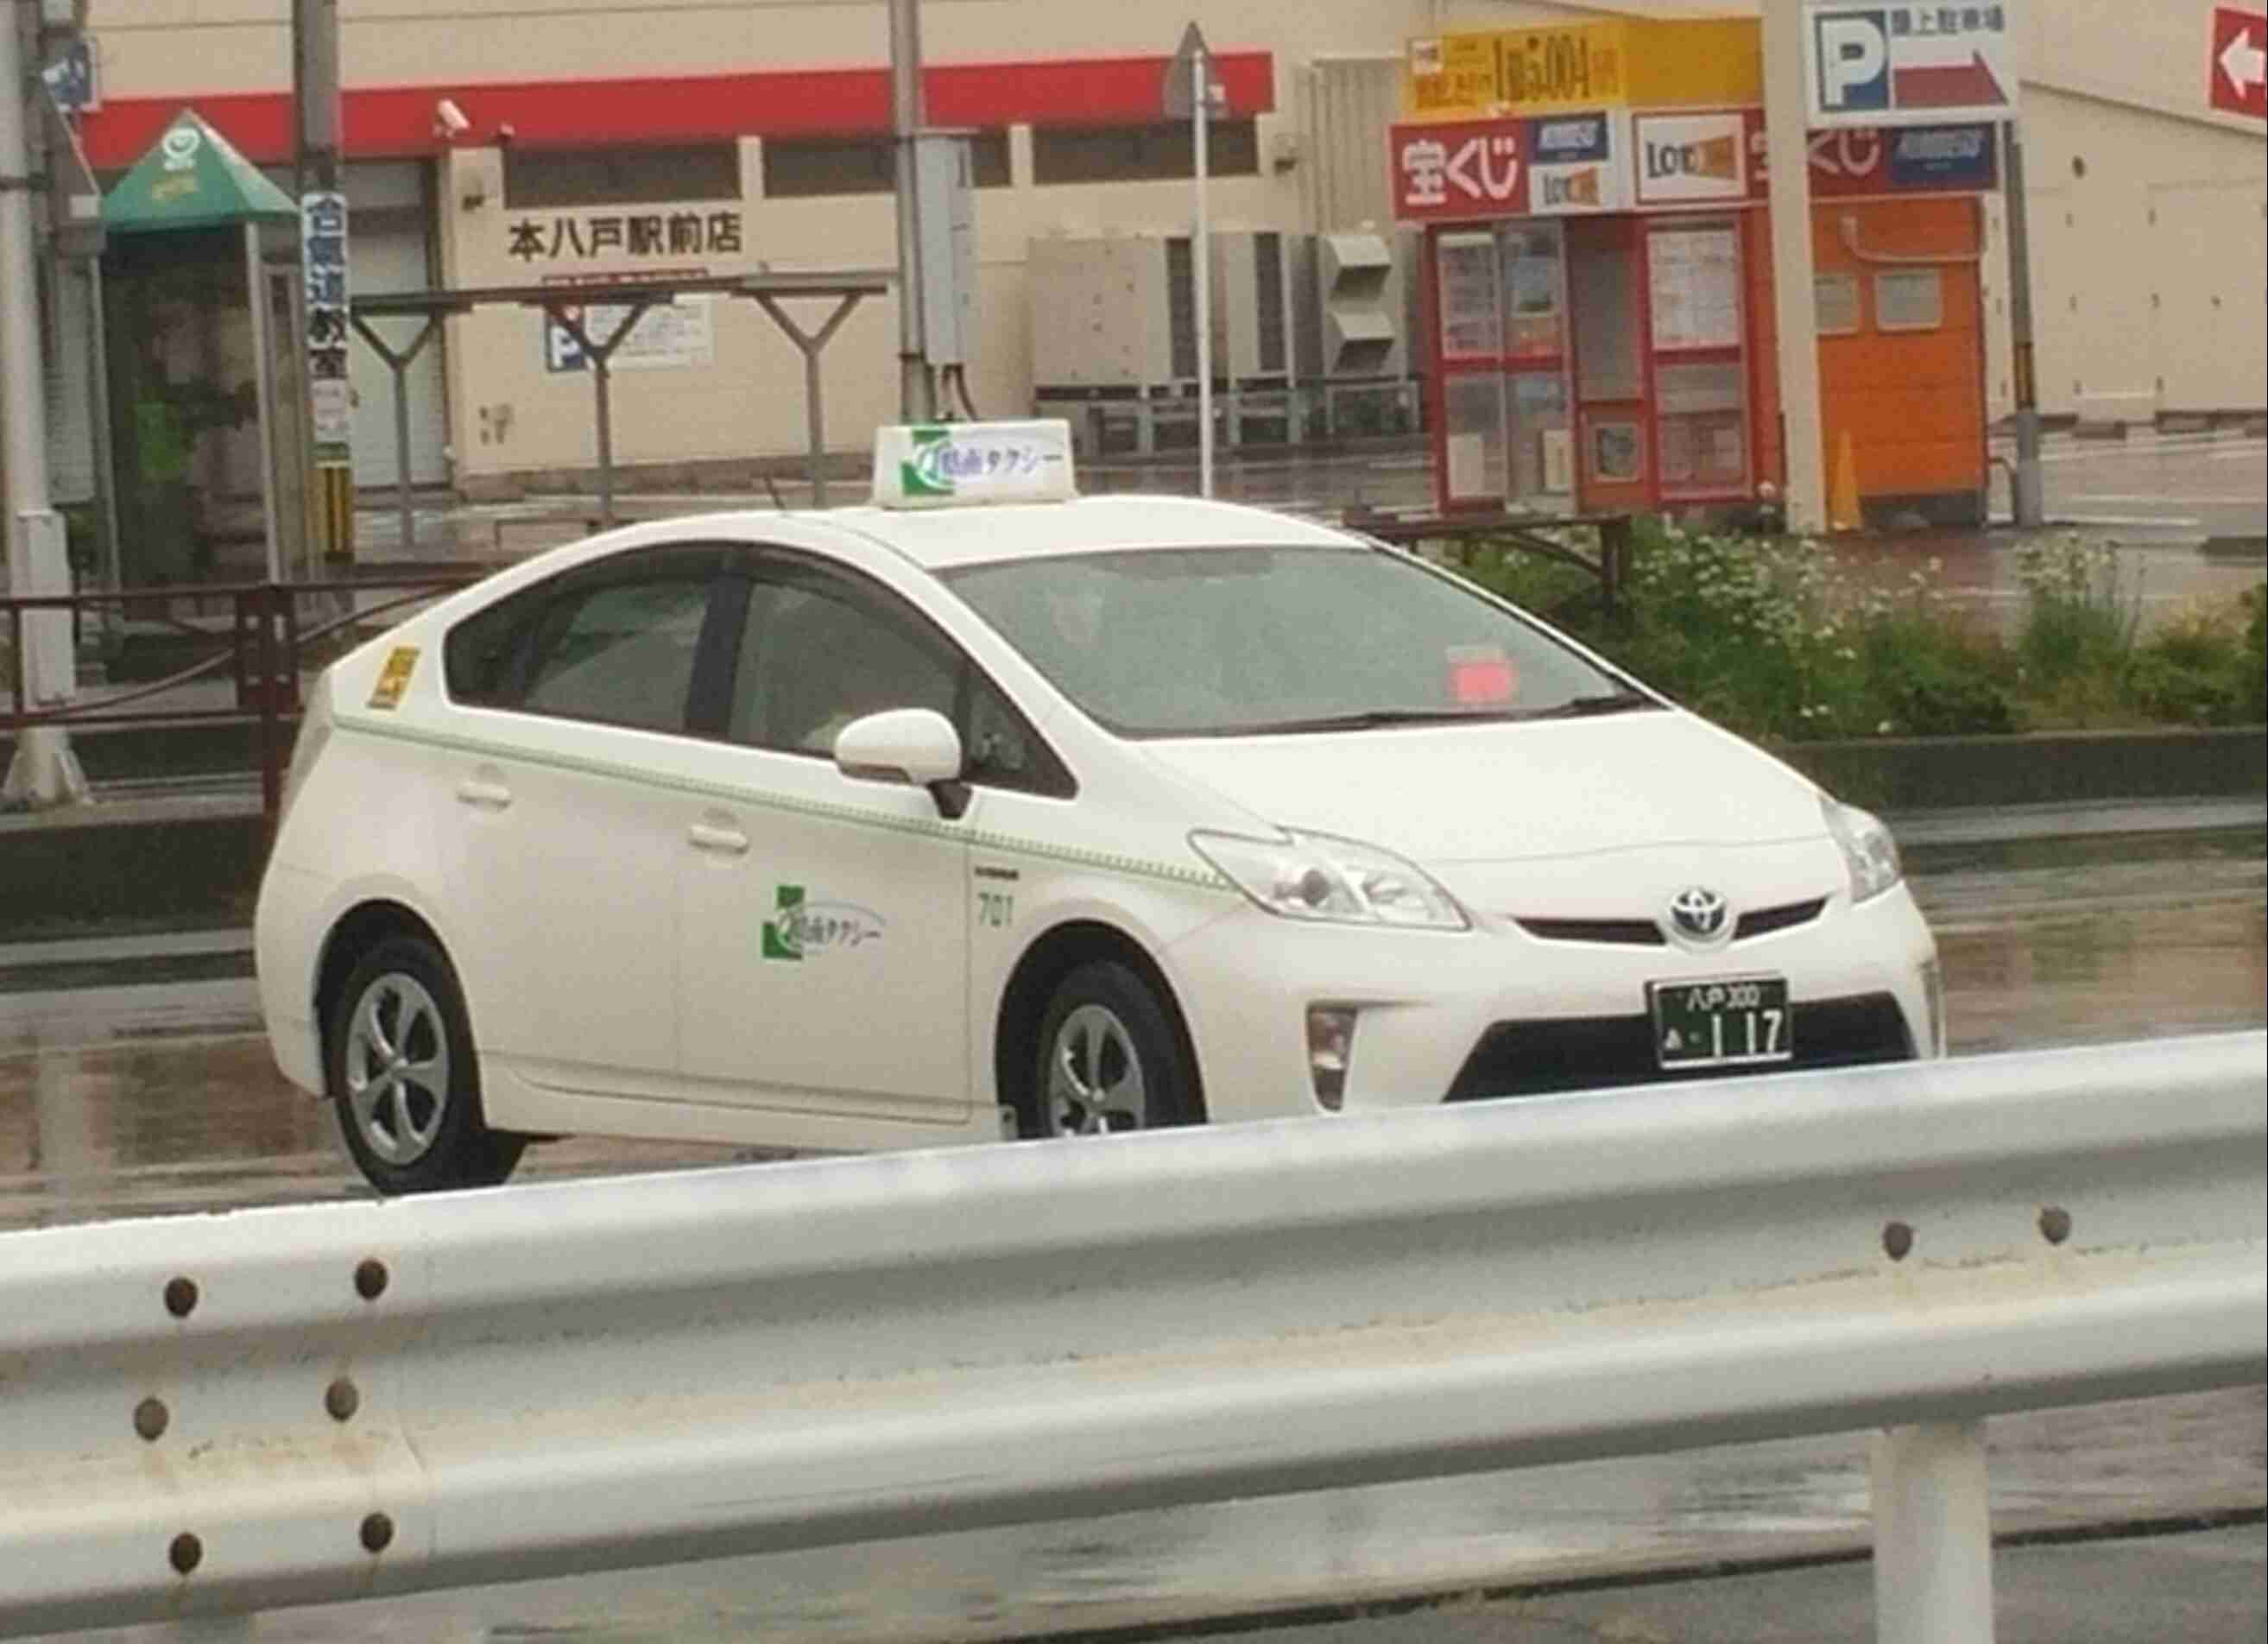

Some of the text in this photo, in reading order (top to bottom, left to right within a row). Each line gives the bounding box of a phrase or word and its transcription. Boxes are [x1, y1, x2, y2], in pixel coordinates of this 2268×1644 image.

[1821, 19, 1885, 105] P
[1402, 138, 1519, 206] 宝くじ
[508, 212, 742, 262] 本八戸駅前店
